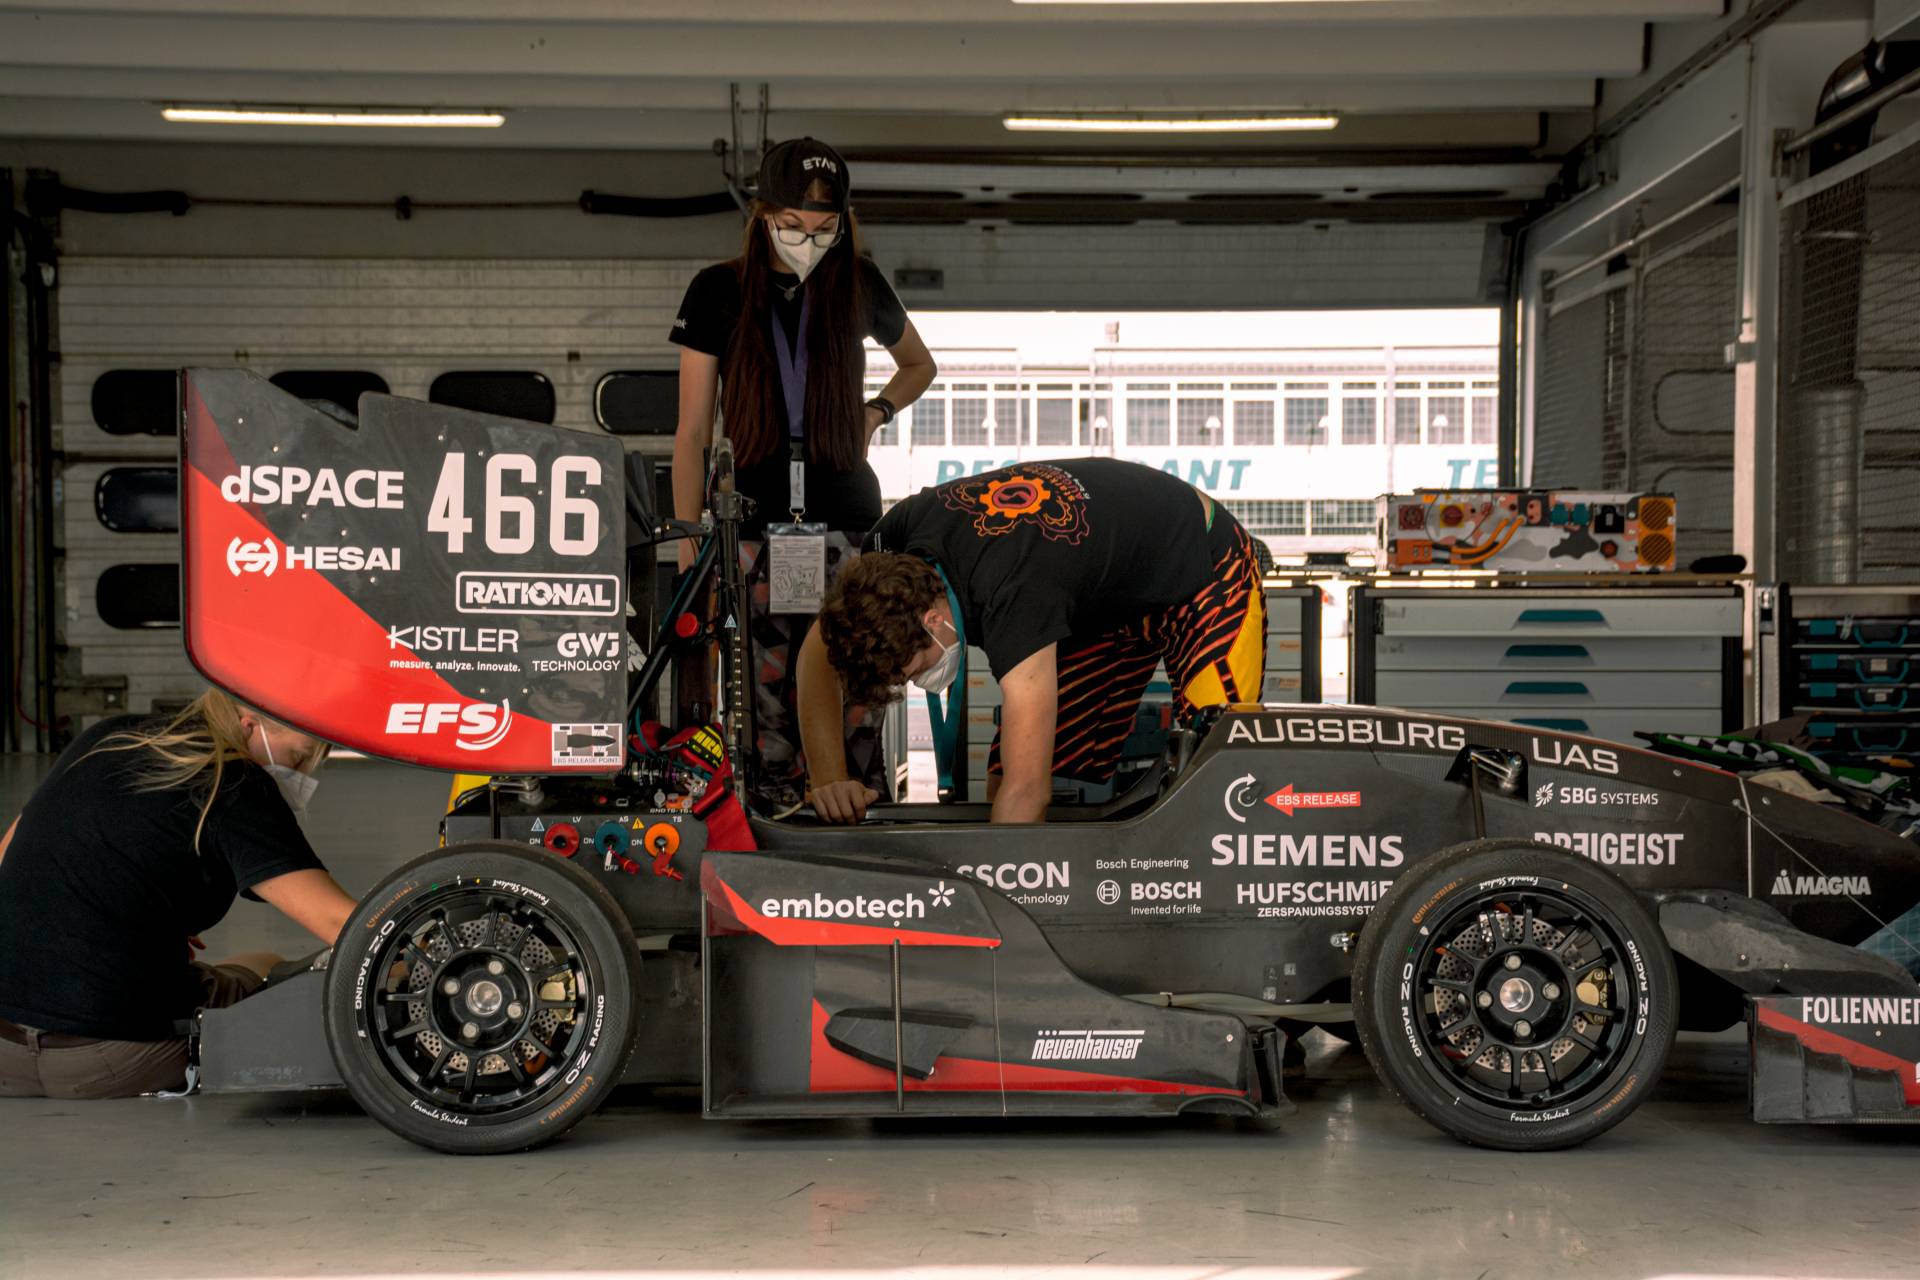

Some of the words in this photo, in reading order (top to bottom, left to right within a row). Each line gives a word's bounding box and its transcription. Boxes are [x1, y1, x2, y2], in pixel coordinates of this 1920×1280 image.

[221, 465, 404, 509] dSPACE
[427, 452, 602, 556] 466
[286, 546, 400, 571] HESAI
[465, 581, 611, 607] RATIONAL
[386, 625, 519, 653] KISTLER
[557, 632, 619, 658] GWJ
[389, 660, 433, 670] measure.
[436, 661, 474, 672] analyze.
[532, 660, 621, 672] TECHNOLOGY
[385, 703, 498, 735] EFS
[1227, 718, 1466, 751] AUGSBURG
[1532, 737, 1619, 775] UAS
[1276, 794, 1300, 806] EBS
[1303, 793, 1357, 805] RELEASE
[1560, 787, 1597, 804] SBG
[1600, 793, 1659, 805] SYSTEMS
[583, 837, 594, 845] ON
[1211, 834, 1404, 868] SIEMENS
[1096, 859, 1127, 869] Bosch
[1130, 858, 1189, 870] Engineering
[1130, 881, 1201, 900] BOSCH
[1795, 876, 1872, 895] MAGNA
[761, 892, 925, 918] embotech
[1006, 894, 1070, 906] echnology
[1131, 905, 1171, 915] Invented
[1172, 905, 1185, 914] for
[1187, 904, 1201, 914] life
[1626, 940, 1648, 992] RACING
[355, 957, 371, 1010] RACING
[589, 994, 605, 1047] RACING
[1402, 1006, 1422, 1057] RACING
